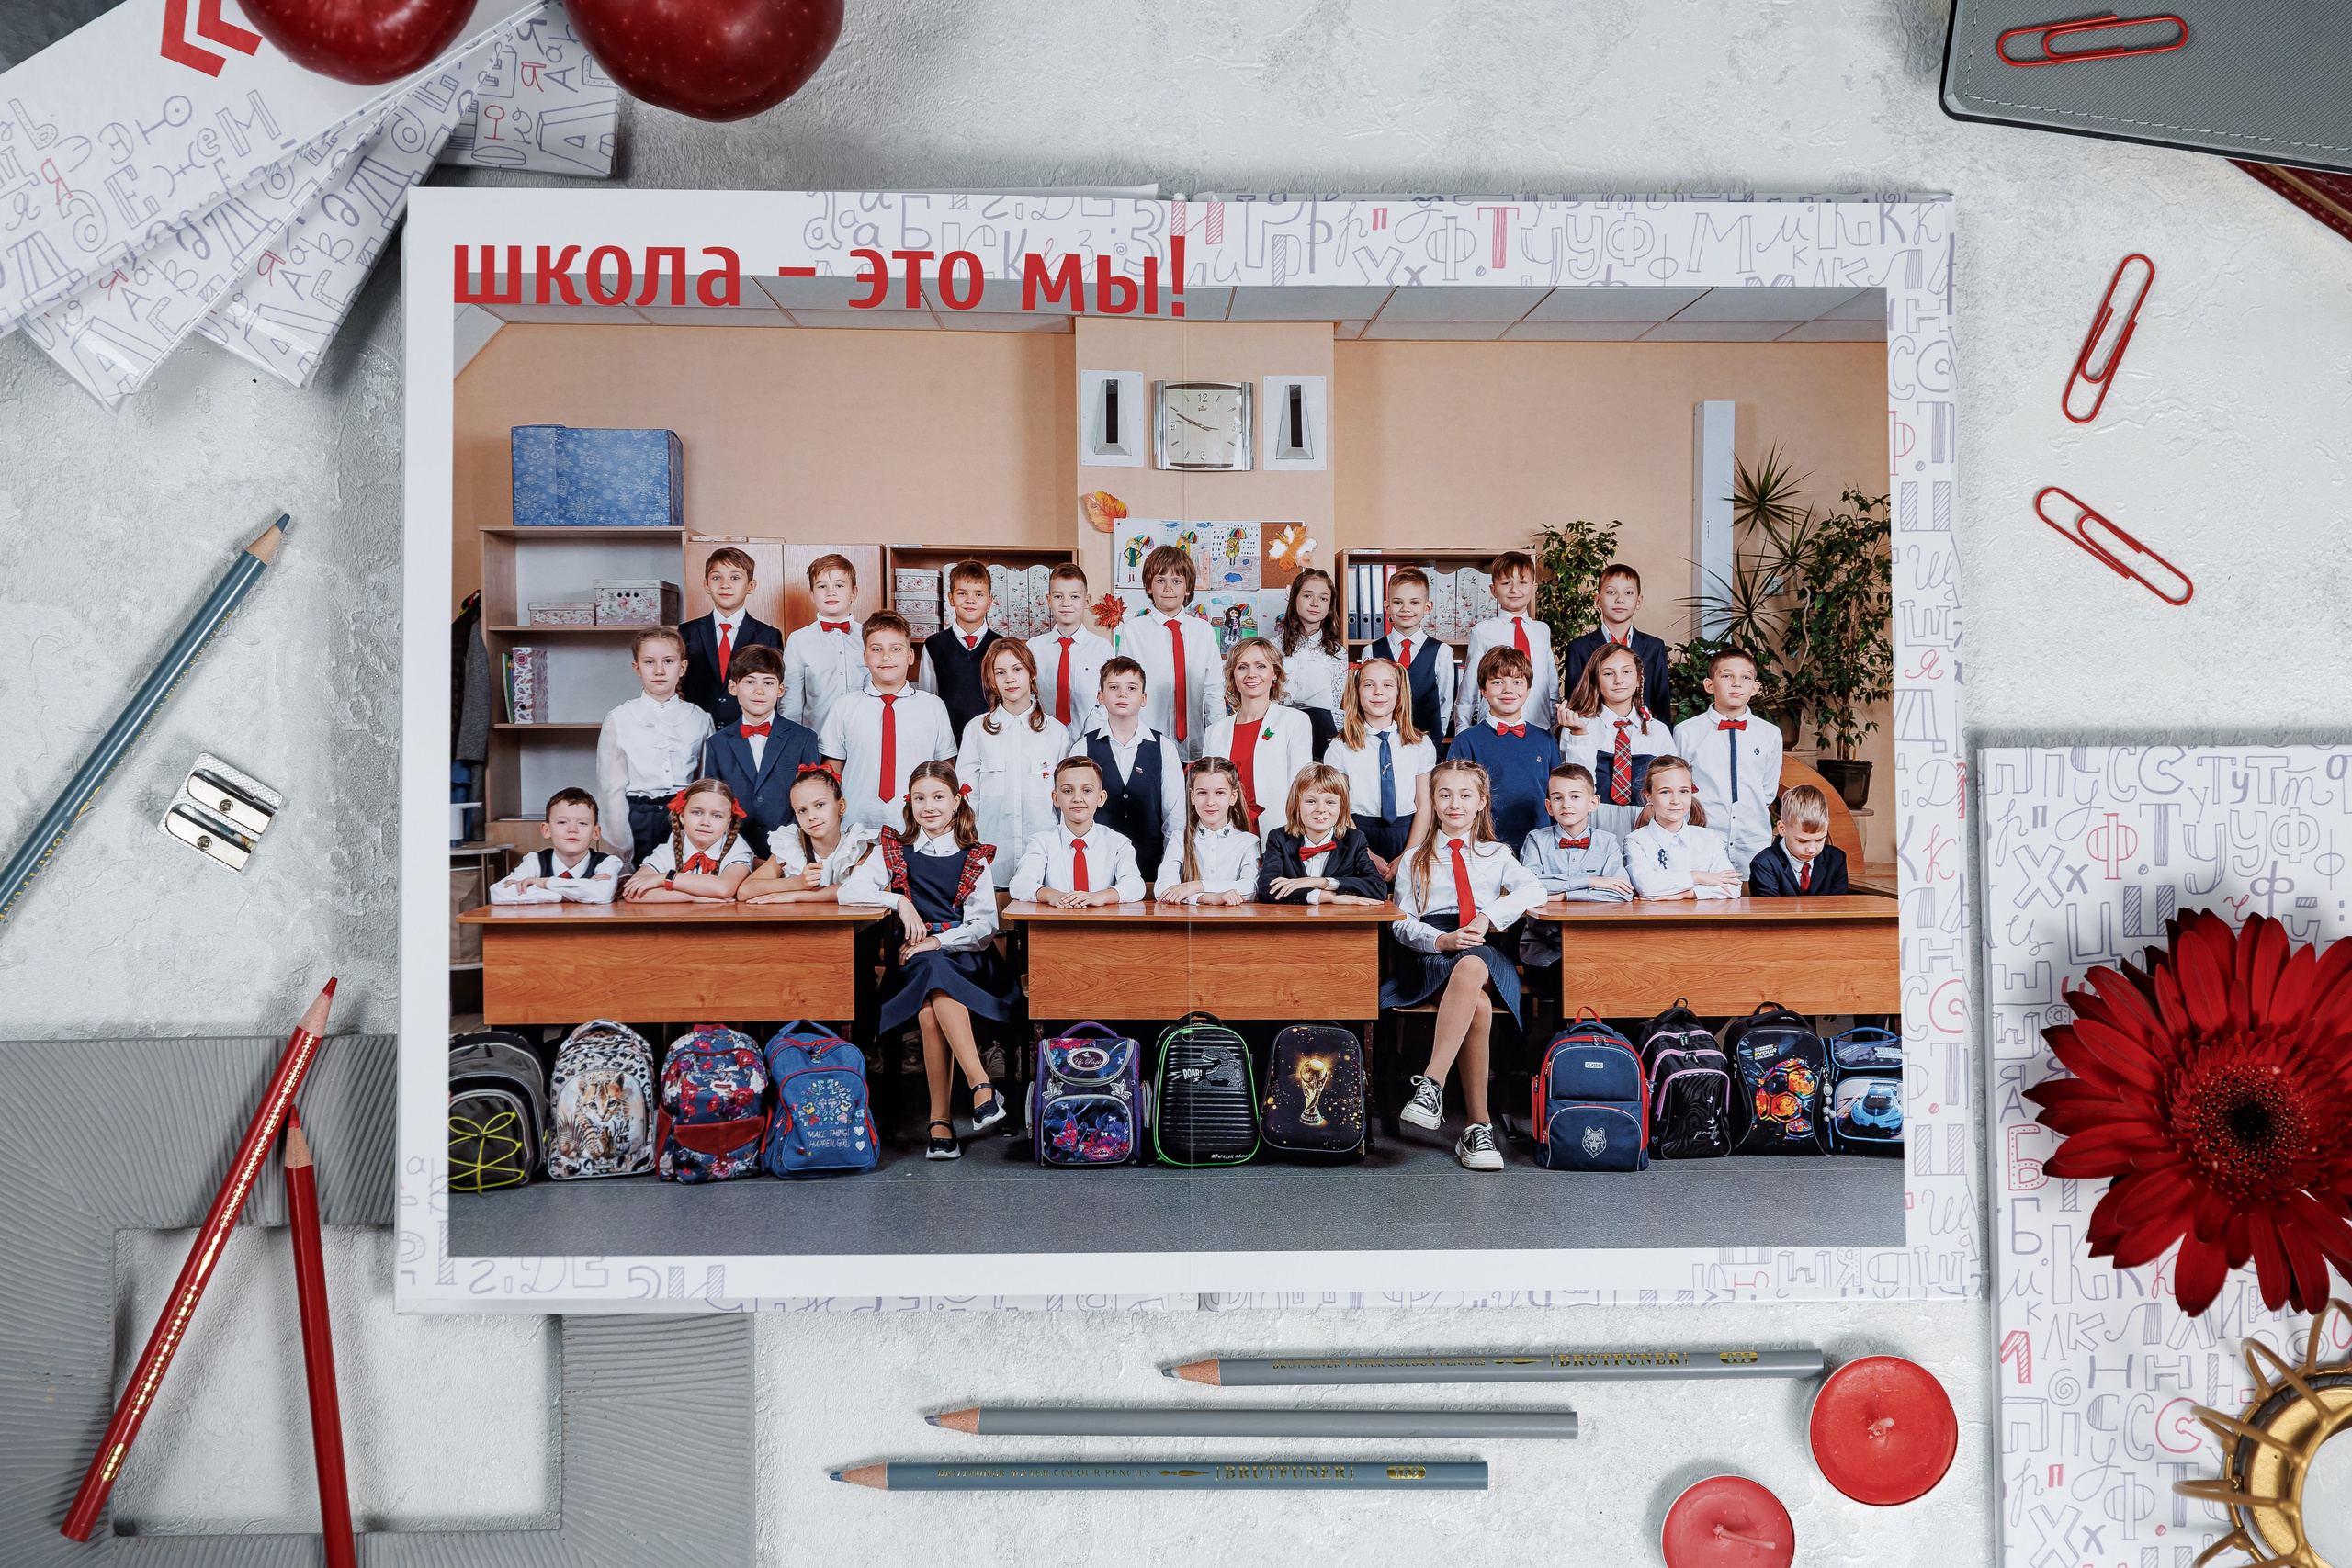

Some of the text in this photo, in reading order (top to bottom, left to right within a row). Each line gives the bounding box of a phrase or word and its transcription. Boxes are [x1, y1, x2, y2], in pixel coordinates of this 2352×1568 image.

[1197, 392, 1209, 403] 12
[1182, 1068, 1203, 1080] ROAR!
[808, 1130, 827, 1138] MAKE
[1344, 1359, 1385, 1369] WATER
[1388, 1358, 1436, 1368] COLOUR
[1439, 1357, 1487, 1367] PENCILS
[1010, 1469, 1050, 1477] WATER
[1053, 1469, 1101, 1478] COLOUR
[1105, 1469, 1151, 1478] PENCILS
